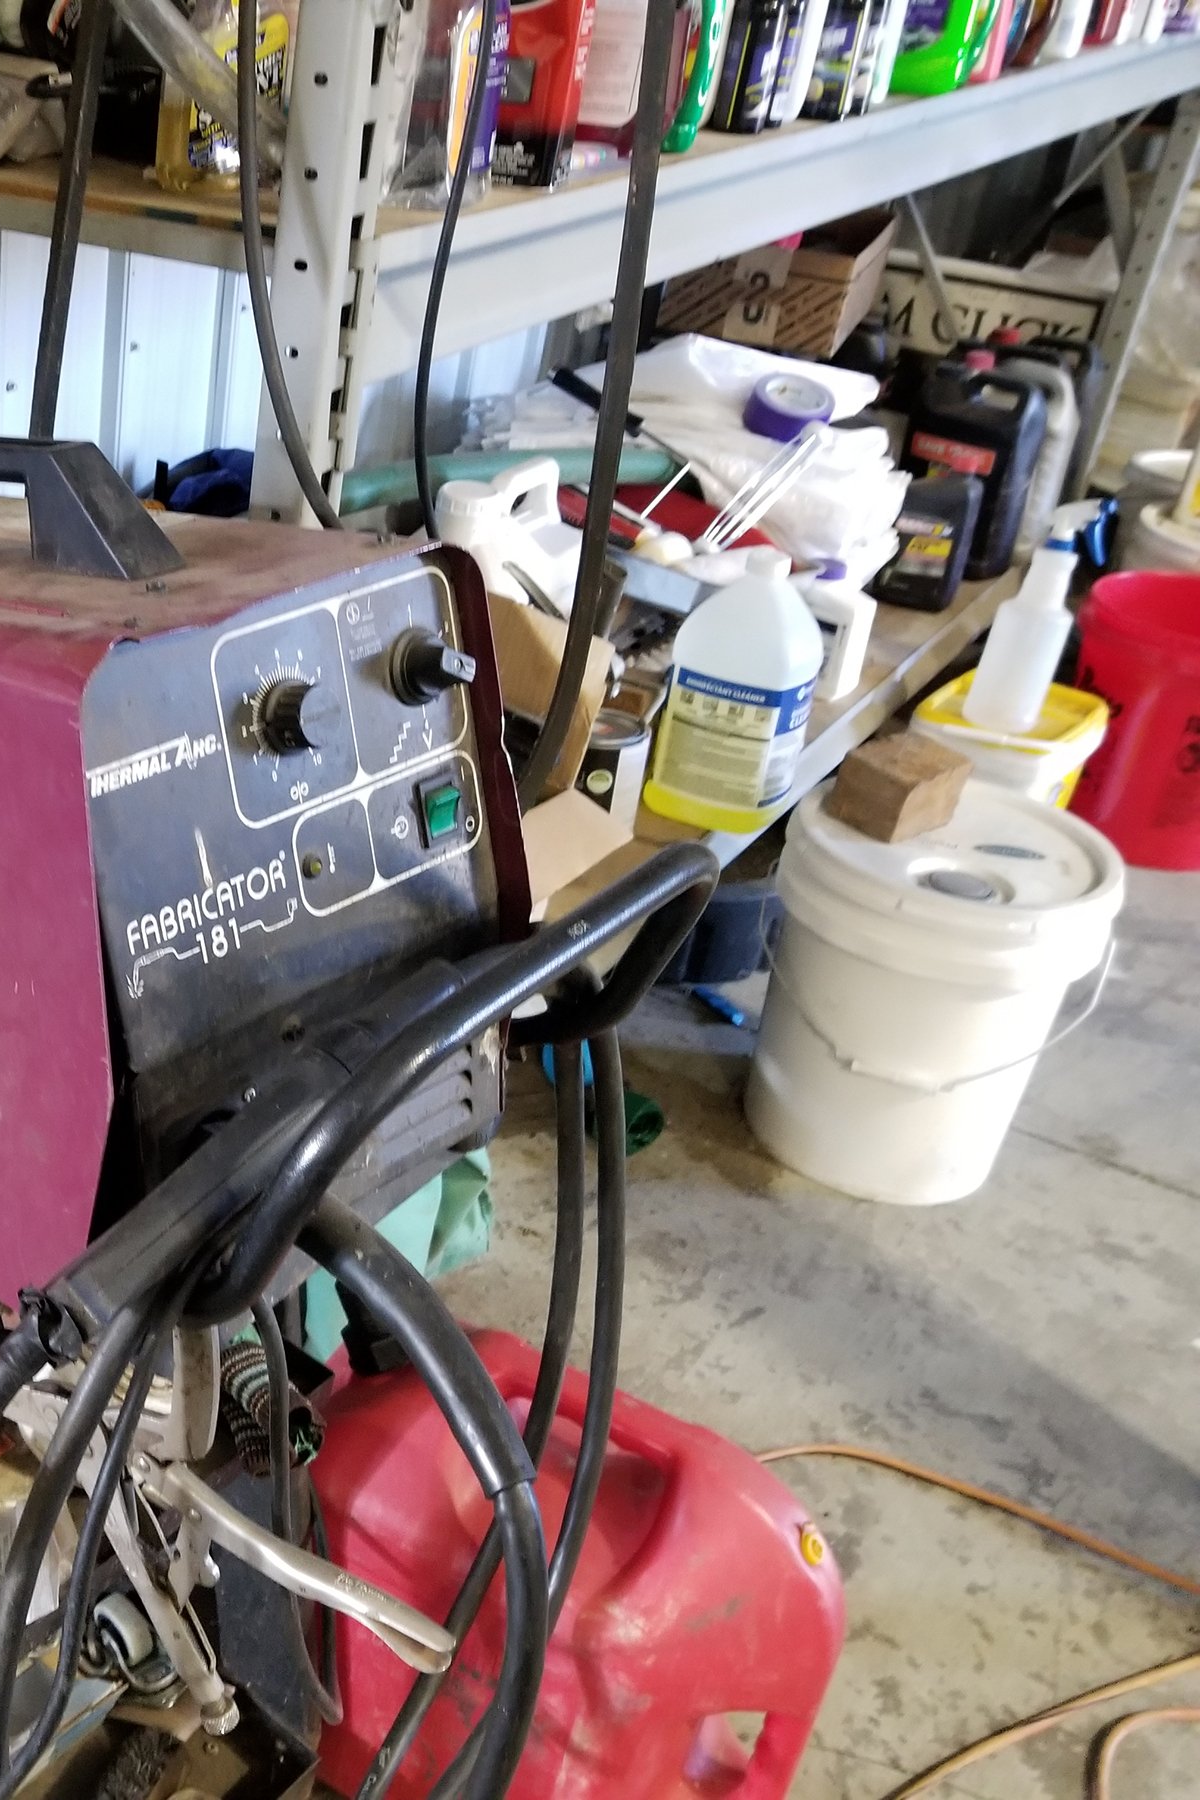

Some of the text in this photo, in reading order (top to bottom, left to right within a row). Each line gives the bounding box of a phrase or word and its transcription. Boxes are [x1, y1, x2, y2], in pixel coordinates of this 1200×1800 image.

[85, 745, 172, 798] THERMAL
[126, 858, 287, 956] FABRICATOR
[195, 917, 241, 965] 181
